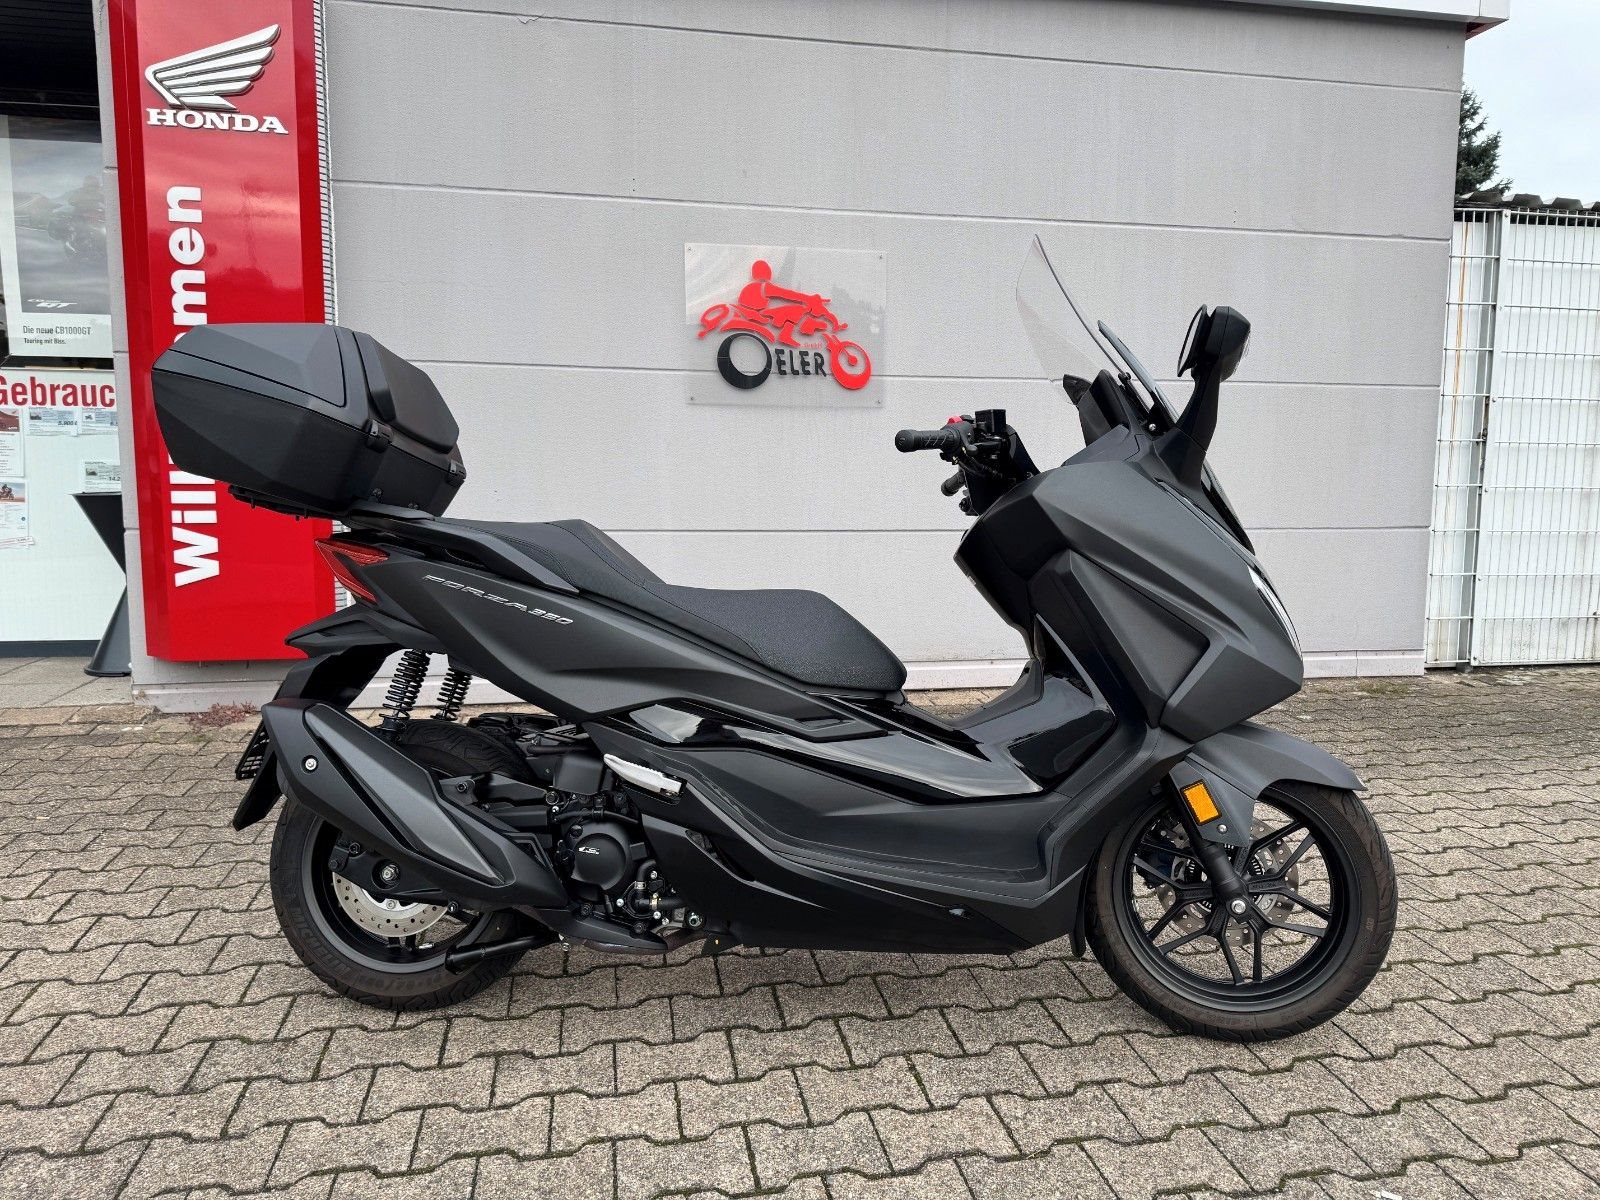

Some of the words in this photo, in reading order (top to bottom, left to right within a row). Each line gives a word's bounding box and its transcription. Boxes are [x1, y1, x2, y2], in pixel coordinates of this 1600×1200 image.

[146, 108, 289, 134] HONDA
[23, 325, 35, 334] Die
[36, 327, 54, 335] neue
[55, 326, 92, 335] CB1000GT
[166, 185, 220, 588] Willmen
[422, 574, 528, 612] FORZA
